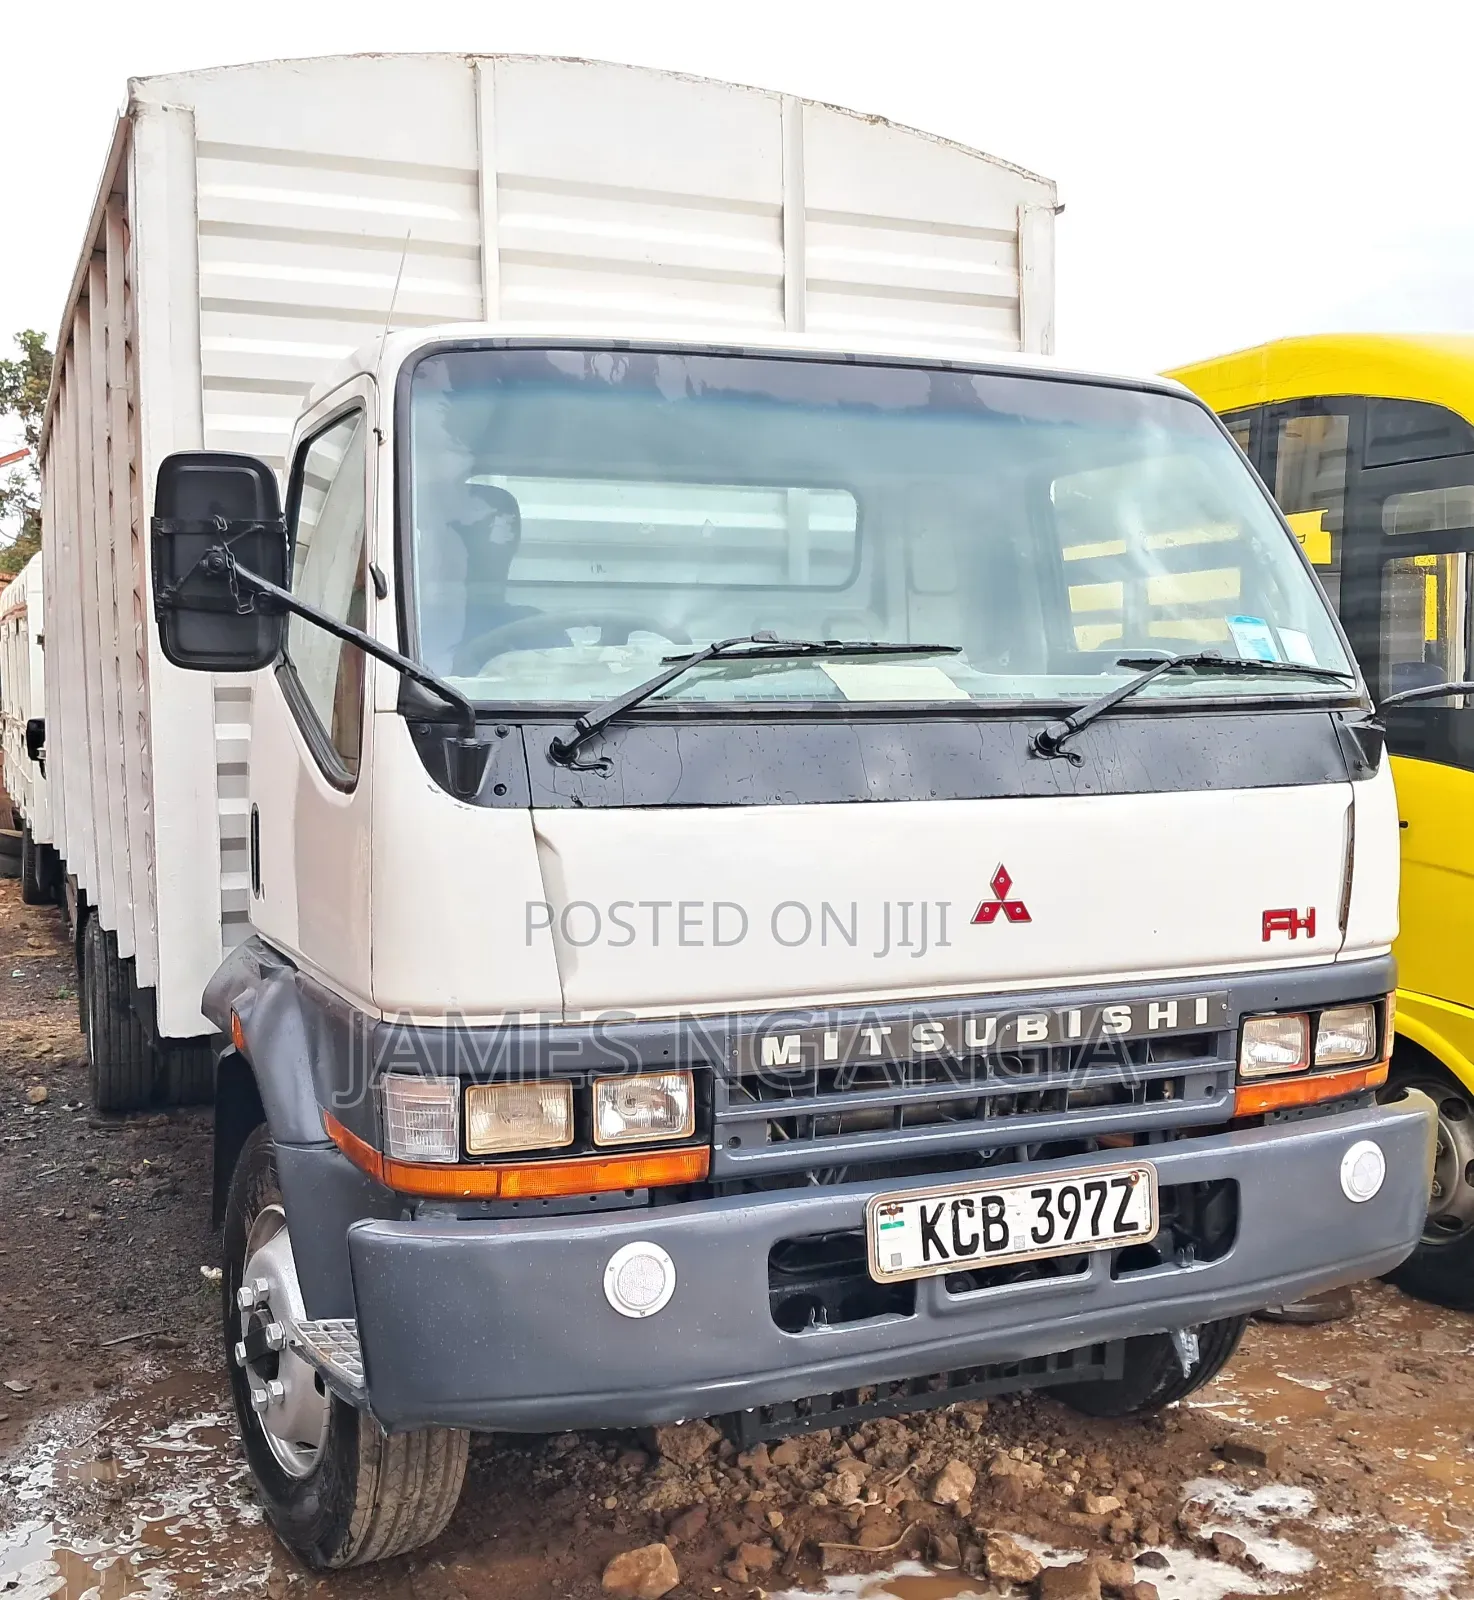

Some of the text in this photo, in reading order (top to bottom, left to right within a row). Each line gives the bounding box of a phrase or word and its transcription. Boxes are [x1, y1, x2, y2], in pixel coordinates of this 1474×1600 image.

[760, 997, 1209, 1067] MITSUBISHI
[920, 1195, 1010, 1262] KCB
[1030, 1178, 1139, 1244] 397Z
